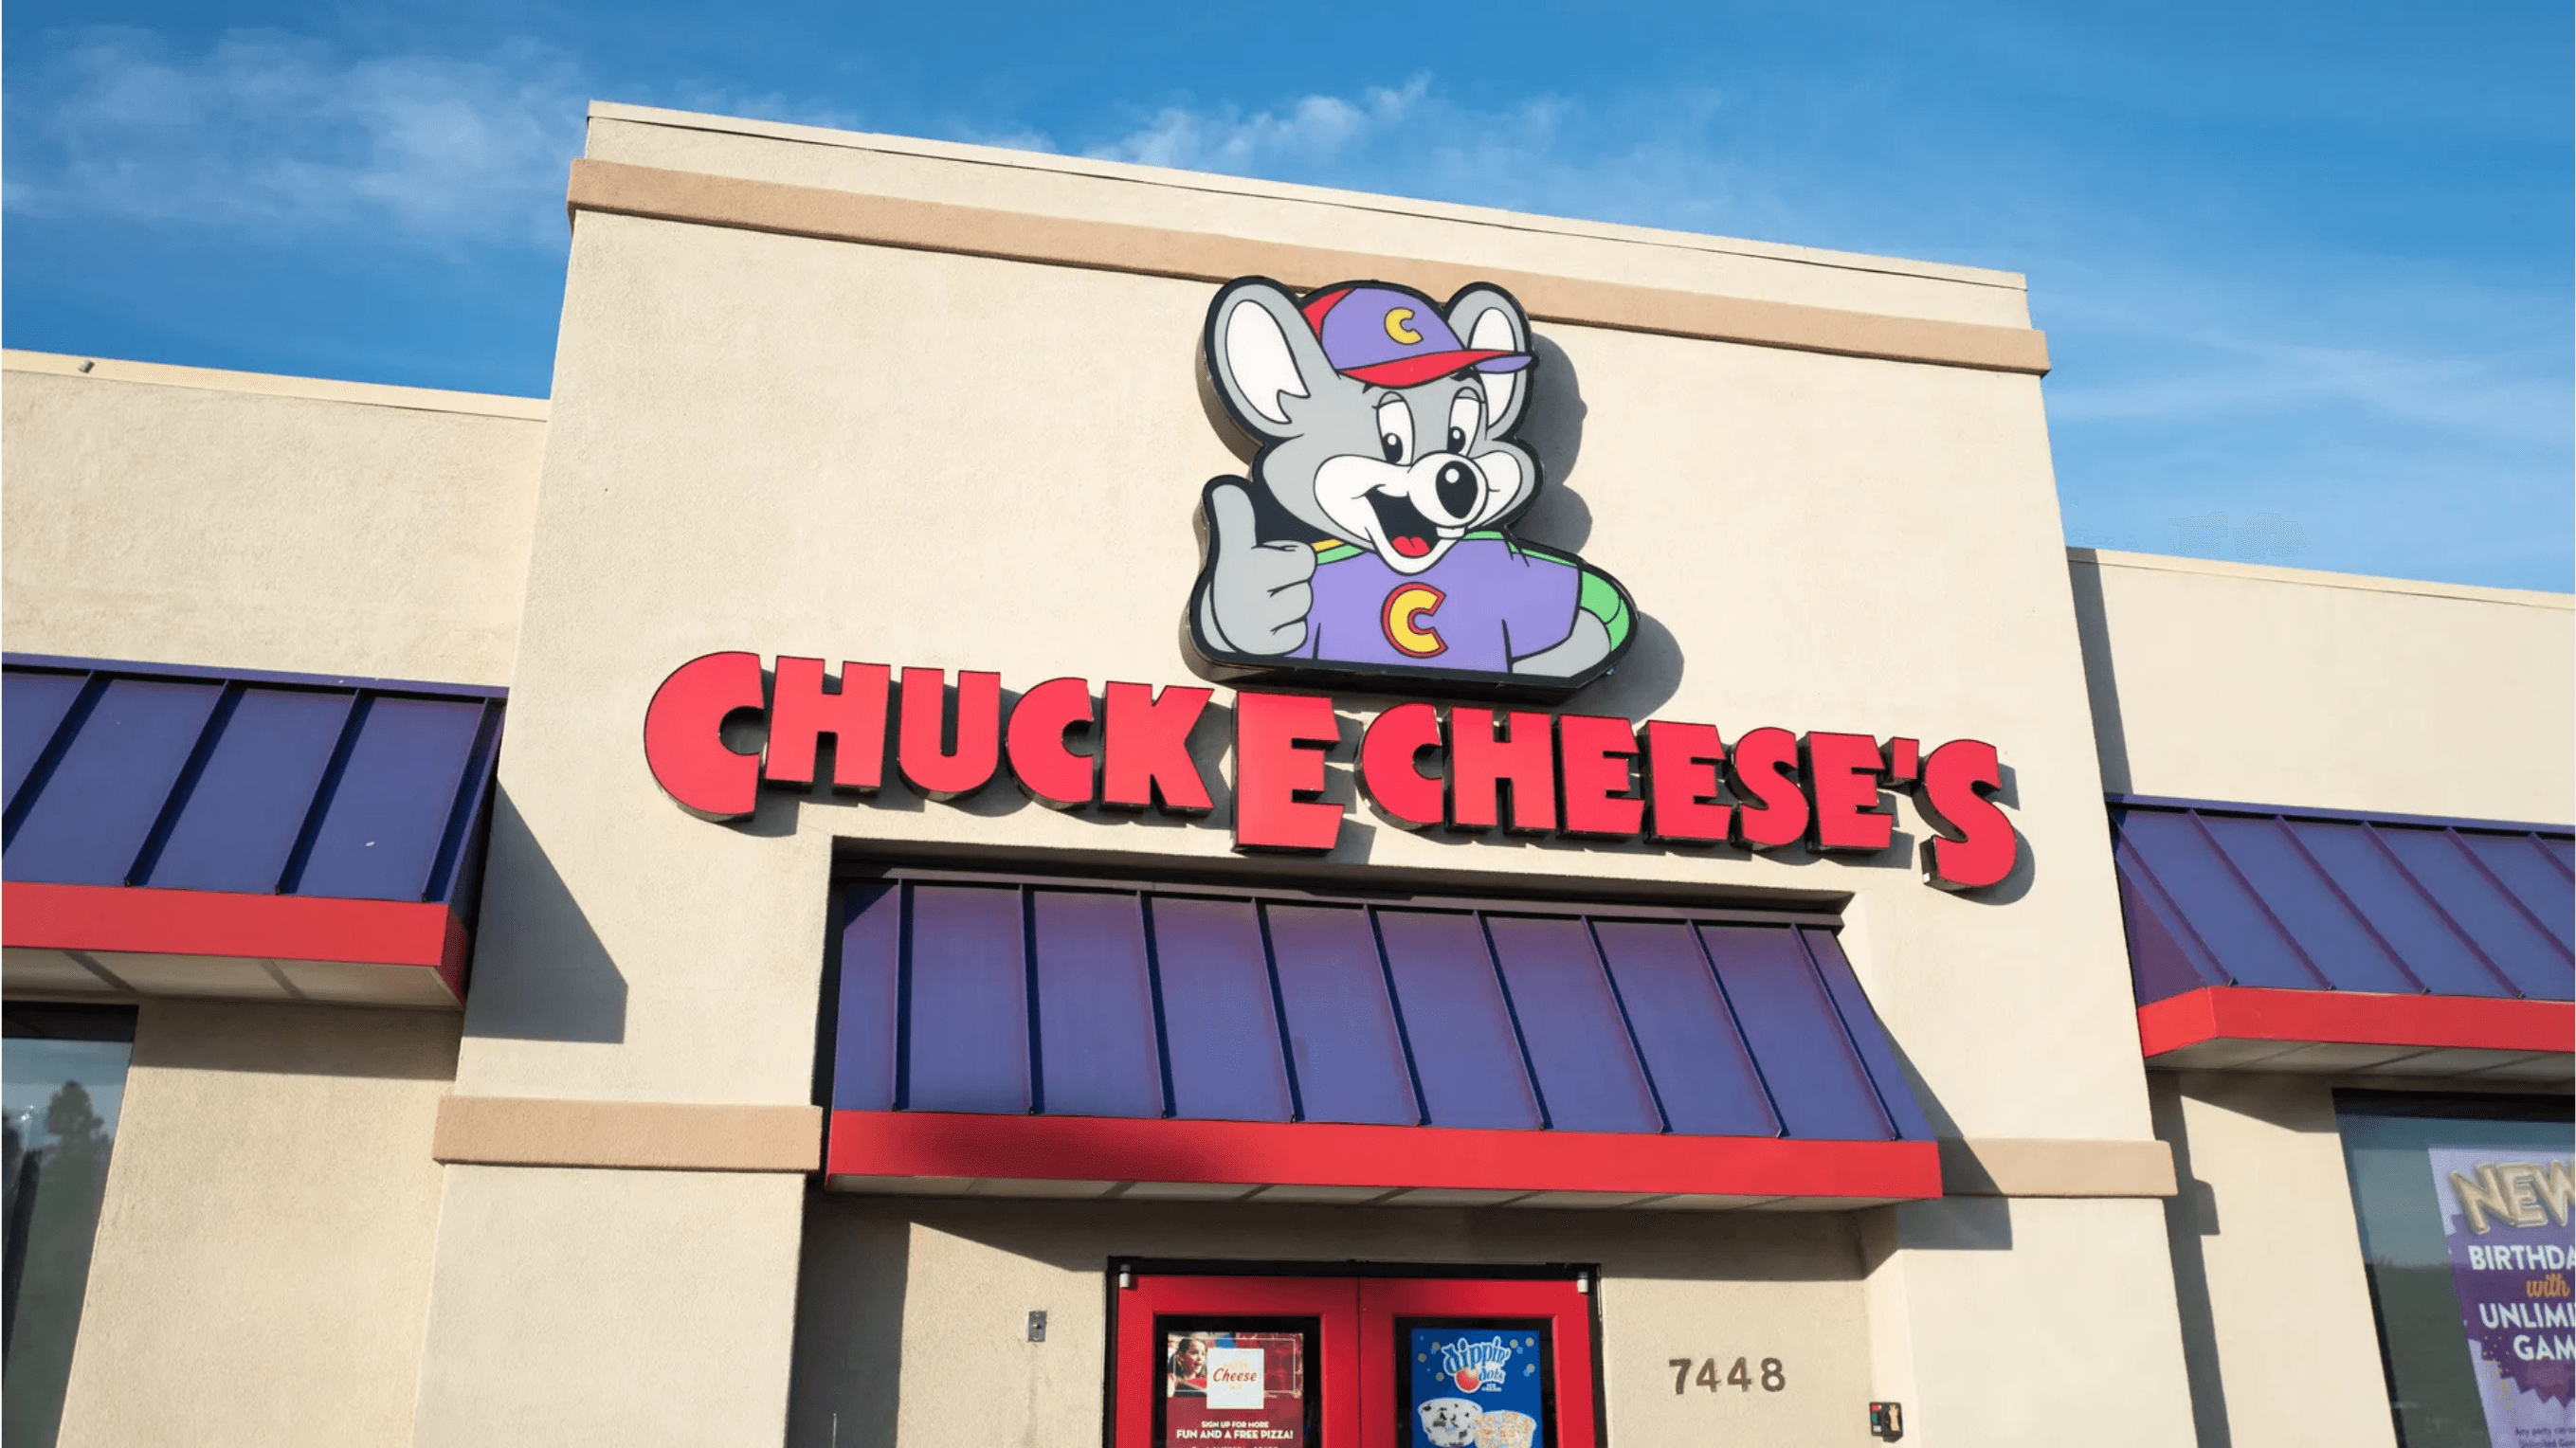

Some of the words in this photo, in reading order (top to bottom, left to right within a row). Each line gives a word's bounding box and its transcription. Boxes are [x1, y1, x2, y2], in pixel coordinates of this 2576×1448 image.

[1384, 307, 1424, 345] C
[1380, 581, 1449, 659] C
[644, 650, 1215, 821] CHUCK
[1234, 691, 1346, 851] E
[1357, 702, 2018, 889] CHEESE'S
[2448, 1159, 2575, 1235] NEW
[2526, 1273, 2571, 1298] with
[2513, 1334, 2575, 1362] GAM
[1212, 1367, 1258, 1383] Cheese
[1668, 1356, 1787, 1396] 7448
[1176, 1429, 1198, 1439] FUN
[1199, 1429, 1223, 1439] AND
[1224, 1429, 1232, 1439] A
[1234, 1429, 1259, 1439] FREE
[1261, 1429, 1294, 1439] PIZZA!
[1201, 1421, 1220, 1429] SIGN
[1220, 1421, 1231, 1429] UP
[1231, 1421, 1247, 1429] FOR
[1247, 1421, 1270, 1429] MORE
